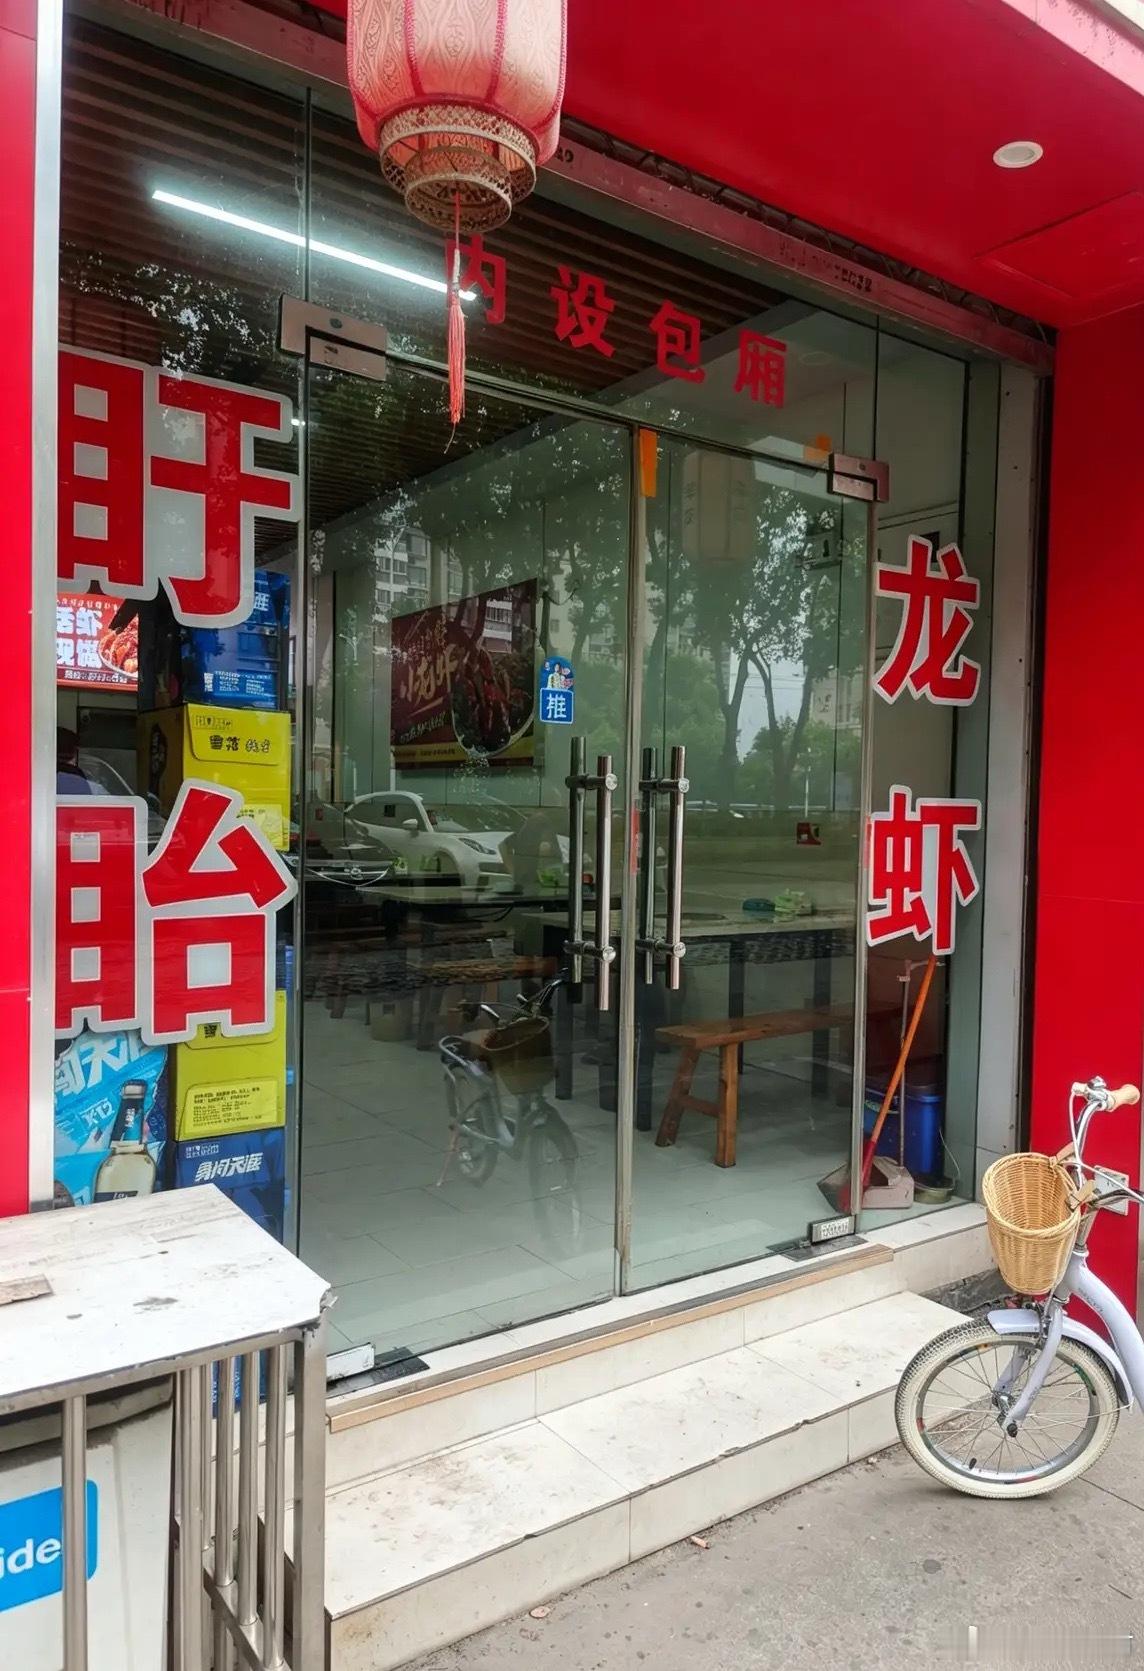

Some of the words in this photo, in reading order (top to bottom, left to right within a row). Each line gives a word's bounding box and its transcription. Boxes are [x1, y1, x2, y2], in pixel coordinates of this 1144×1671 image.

[445, 232, 787, 410] 内设包厢
[56, 346, 298, 1042] 盱眙
[546, 692, 567, 719] 推
[867, 535, 981, 954] 龙虾
